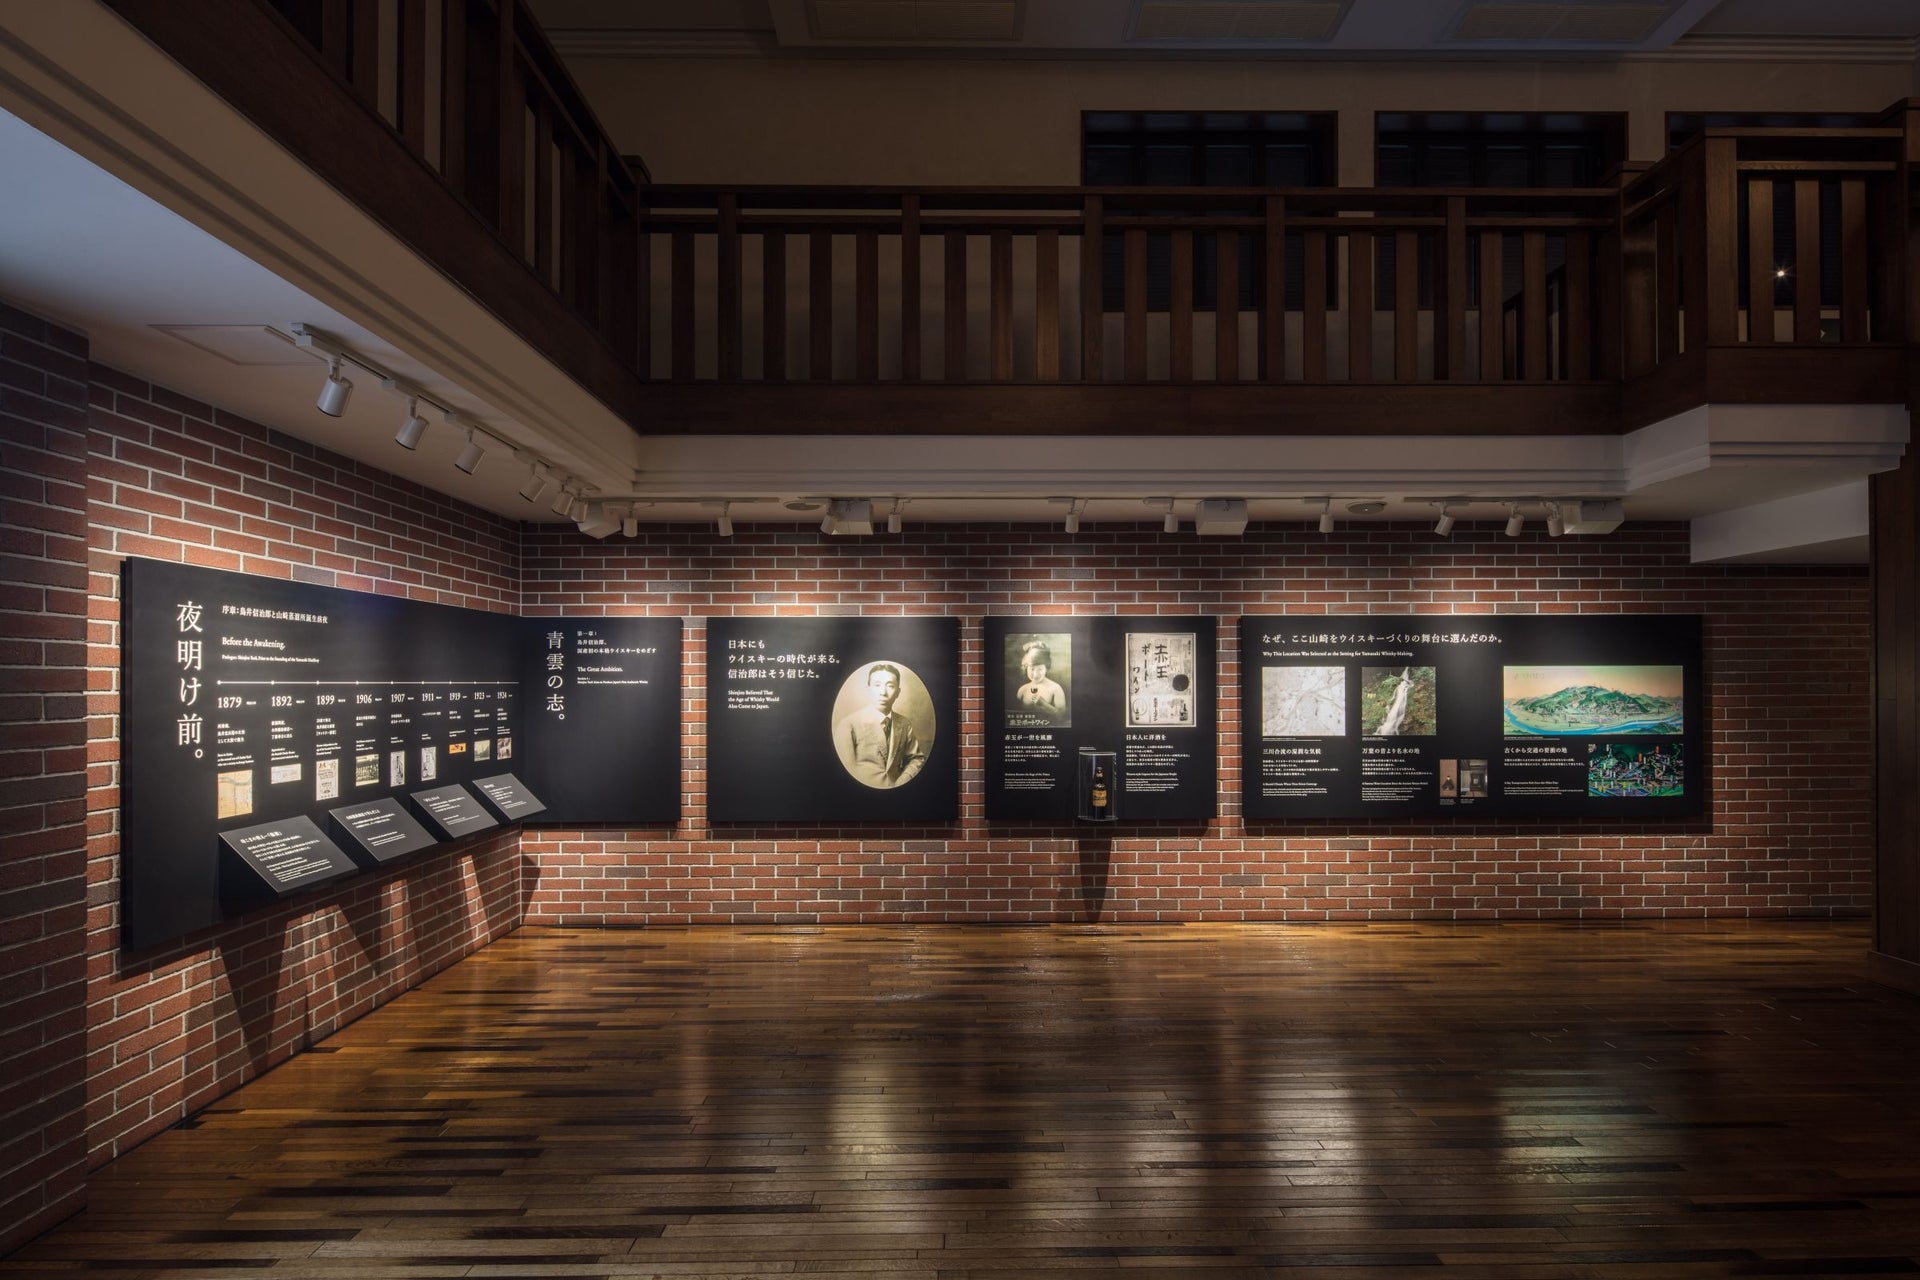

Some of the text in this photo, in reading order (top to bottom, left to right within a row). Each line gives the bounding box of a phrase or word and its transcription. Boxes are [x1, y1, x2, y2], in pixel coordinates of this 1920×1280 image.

[222, 636, 242, 646] Before
[242, 638, 253, 647] the
[728, 639, 765, 649] 日本にも
[728, 654, 840, 664] ウイスキーの時代が来る。
[546, 631, 565, 720] 青雲の志。
[728, 669, 820, 679] 信治郎はそう信じた。
[176, 600, 203, 760] 夜明け前。
[271, 696, 292, 707] 1892
[316, 695, 335, 705] 1899
[356, 694, 372, 704] 1906
[391, 693, 405, 703] 1907
[422, 693, 434, 701] 1911
[217, 696, 242, 709] 1879
